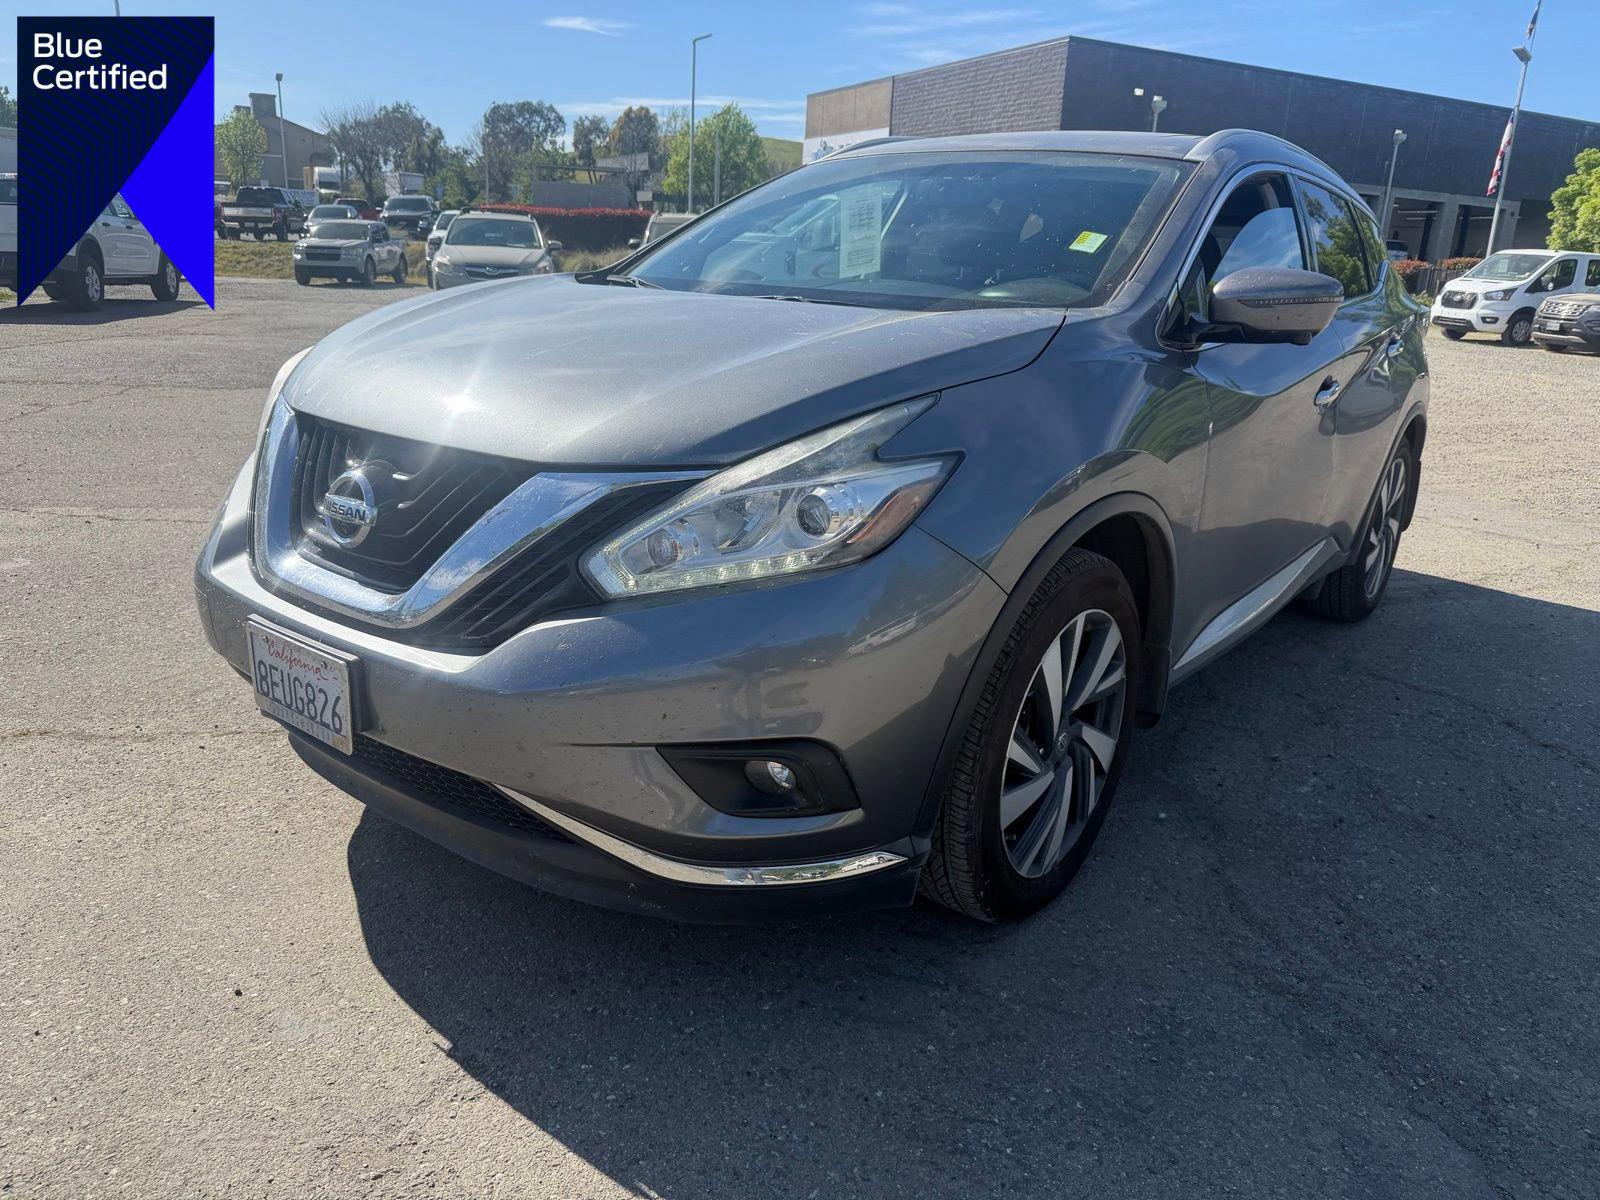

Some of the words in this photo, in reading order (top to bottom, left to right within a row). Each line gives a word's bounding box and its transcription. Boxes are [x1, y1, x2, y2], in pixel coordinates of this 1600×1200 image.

[324, 499, 366, 521] NISSAN
[267, 640, 326, 678] California
[257, 659, 343, 735] 8EUG826
